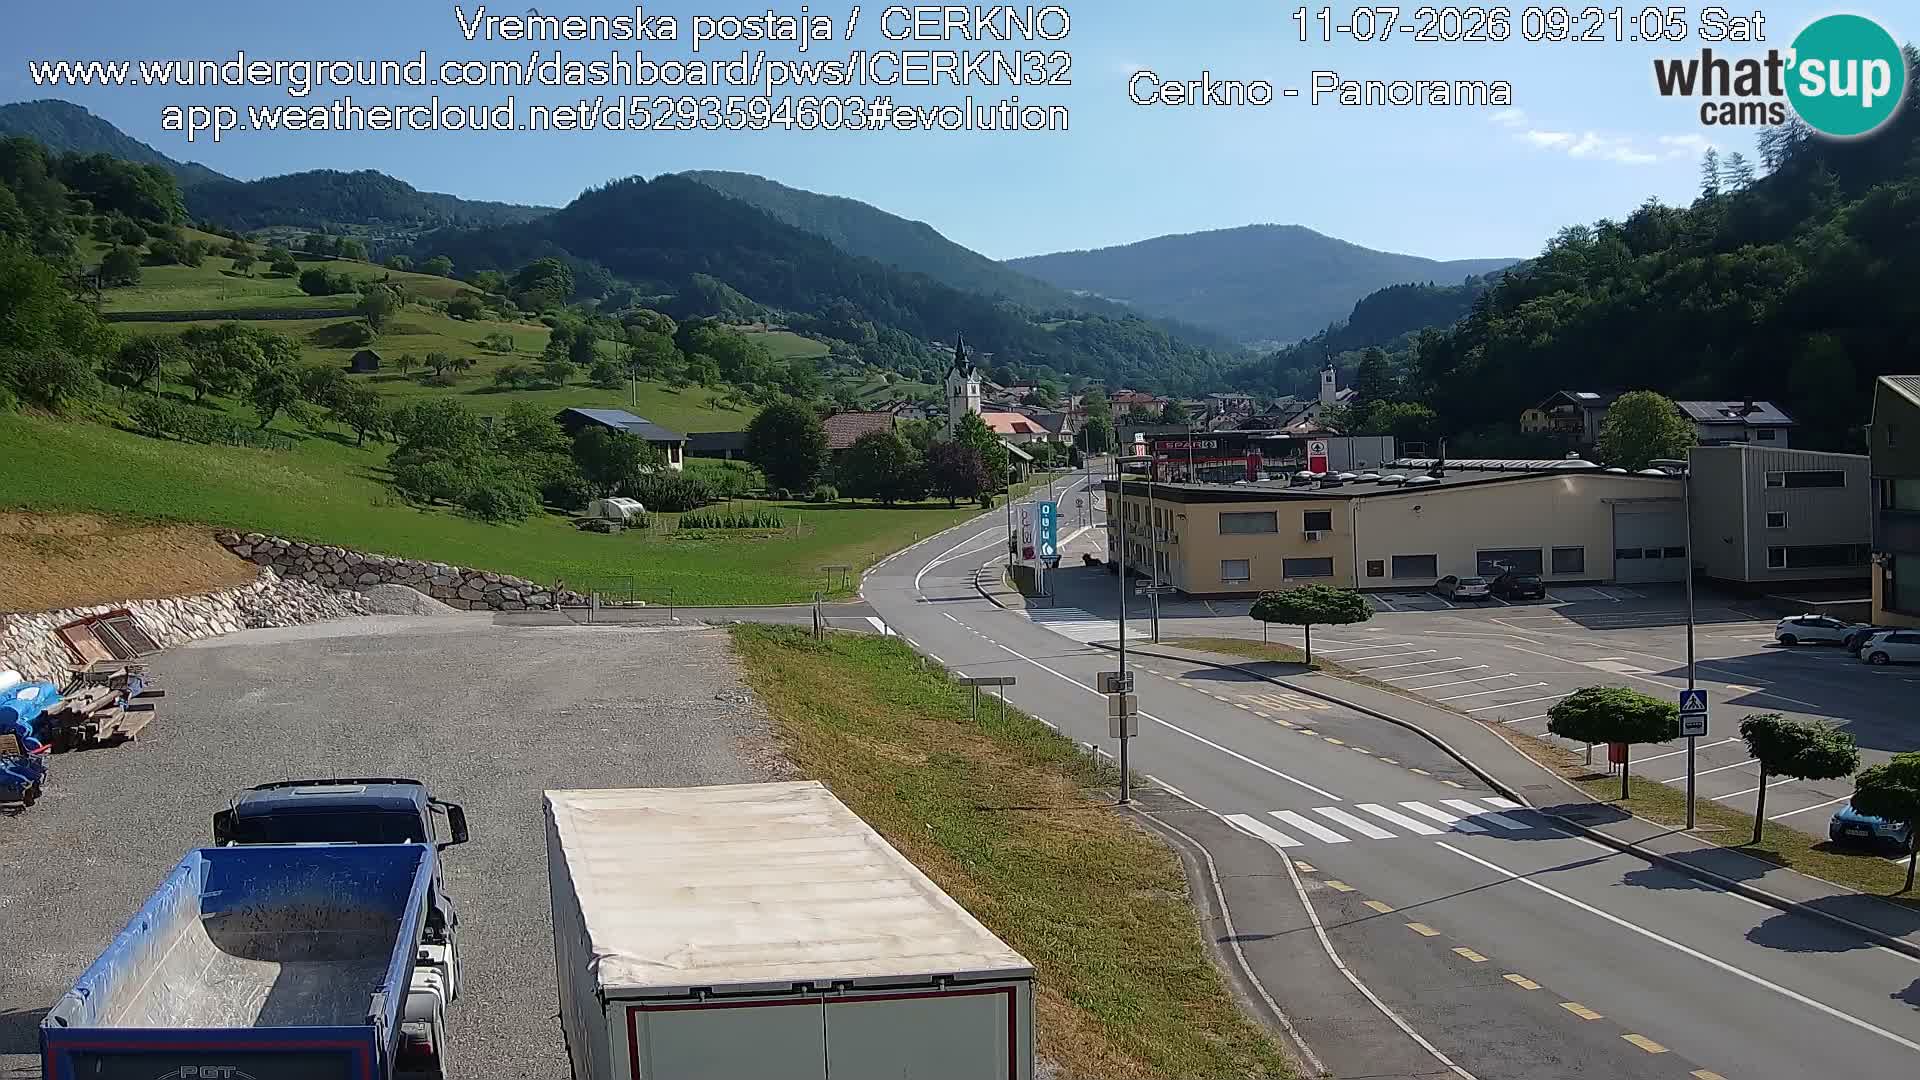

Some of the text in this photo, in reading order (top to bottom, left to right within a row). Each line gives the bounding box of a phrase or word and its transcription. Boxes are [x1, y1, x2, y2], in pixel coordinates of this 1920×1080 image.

[1165, 440, 1202, 449] SPAR
[1238, 693, 1332, 712] BUS
[179, 1065, 238, 1079] PGT
